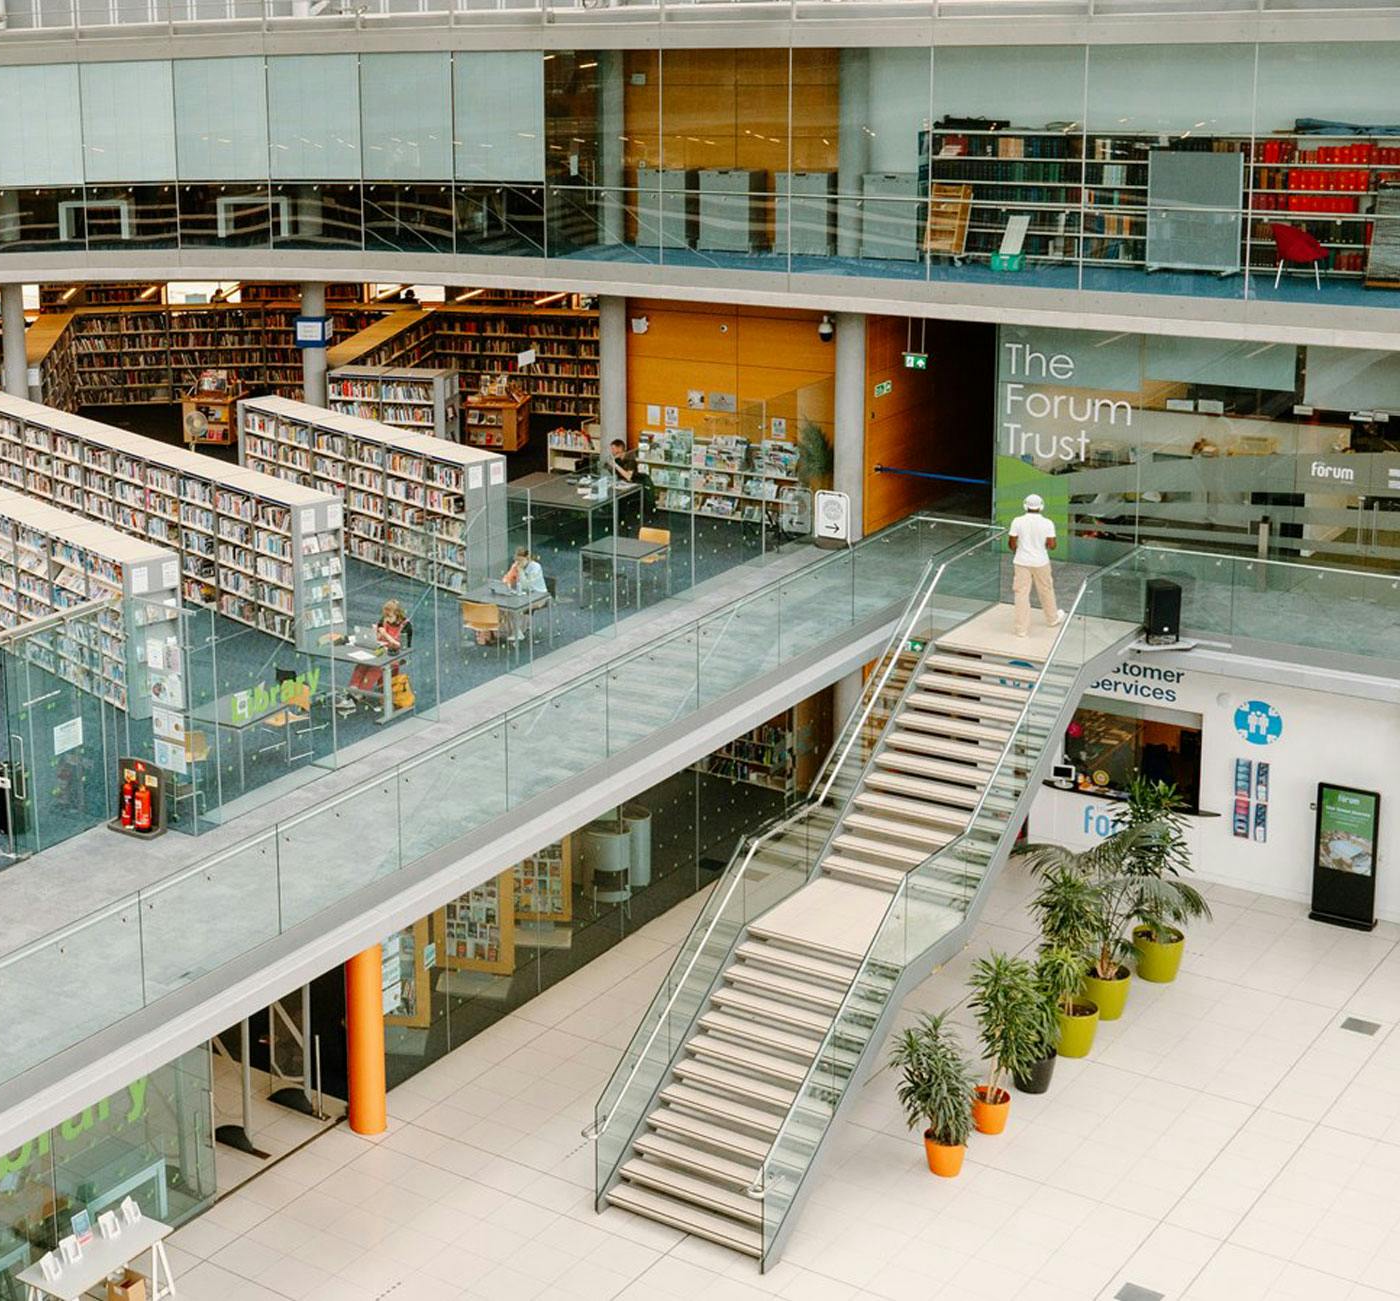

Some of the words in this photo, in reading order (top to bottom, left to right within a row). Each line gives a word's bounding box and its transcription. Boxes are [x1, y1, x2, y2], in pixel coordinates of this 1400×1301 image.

[1004, 343, 1075, 379] The
[1006, 383, 1132, 426] Forum
[1003, 422, 1091, 462] Trust
[1311, 460, 1354, 481] forum
[231, 667, 319, 726] Library
